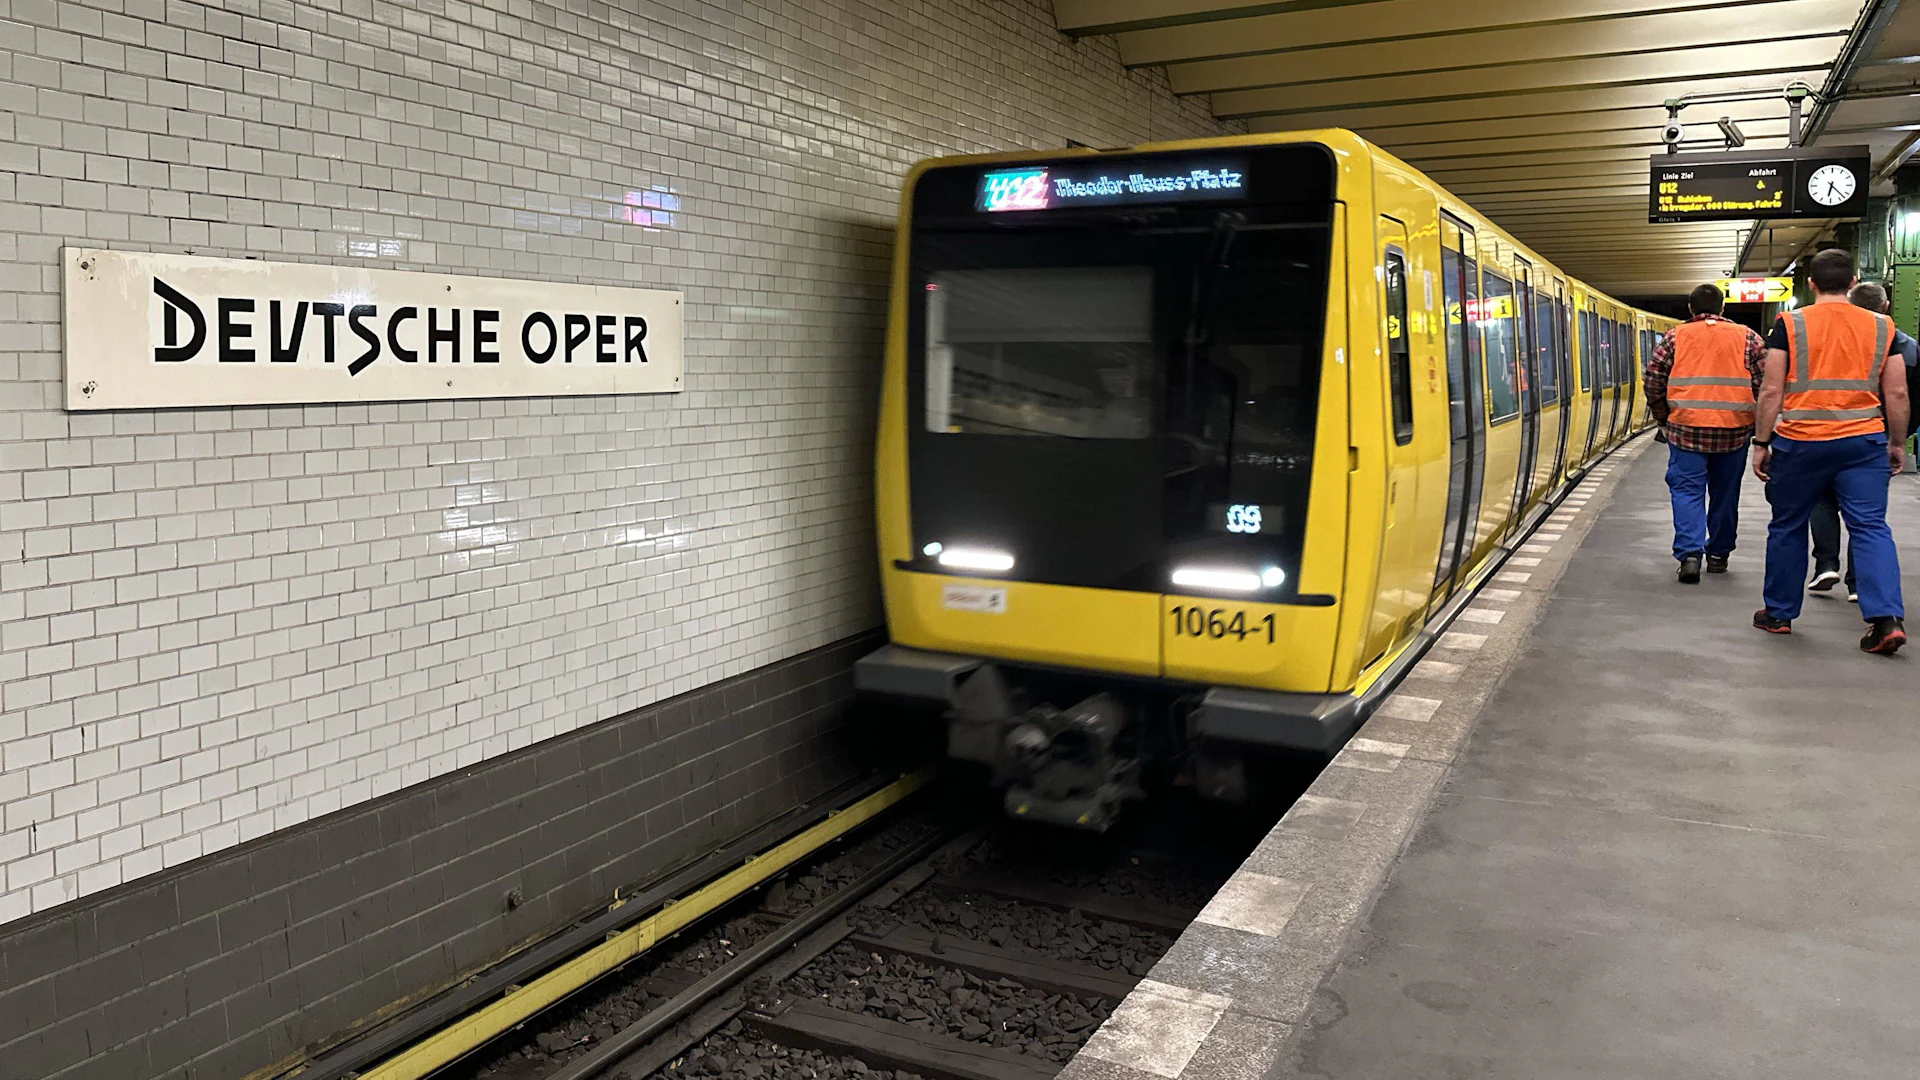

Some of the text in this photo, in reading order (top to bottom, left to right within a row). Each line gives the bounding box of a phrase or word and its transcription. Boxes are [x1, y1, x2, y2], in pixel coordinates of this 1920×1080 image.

[1681, 172, 1694, 180] Ziel
[1748, 169, 1777, 177] Abfahrt
[1659, 182, 1678, 194] U12
[1659, 196, 1673, 204] U12
[153, 276, 649, 377] DEUTSCHE OPER
[1171, 605, 1276, 645] 1064-1
